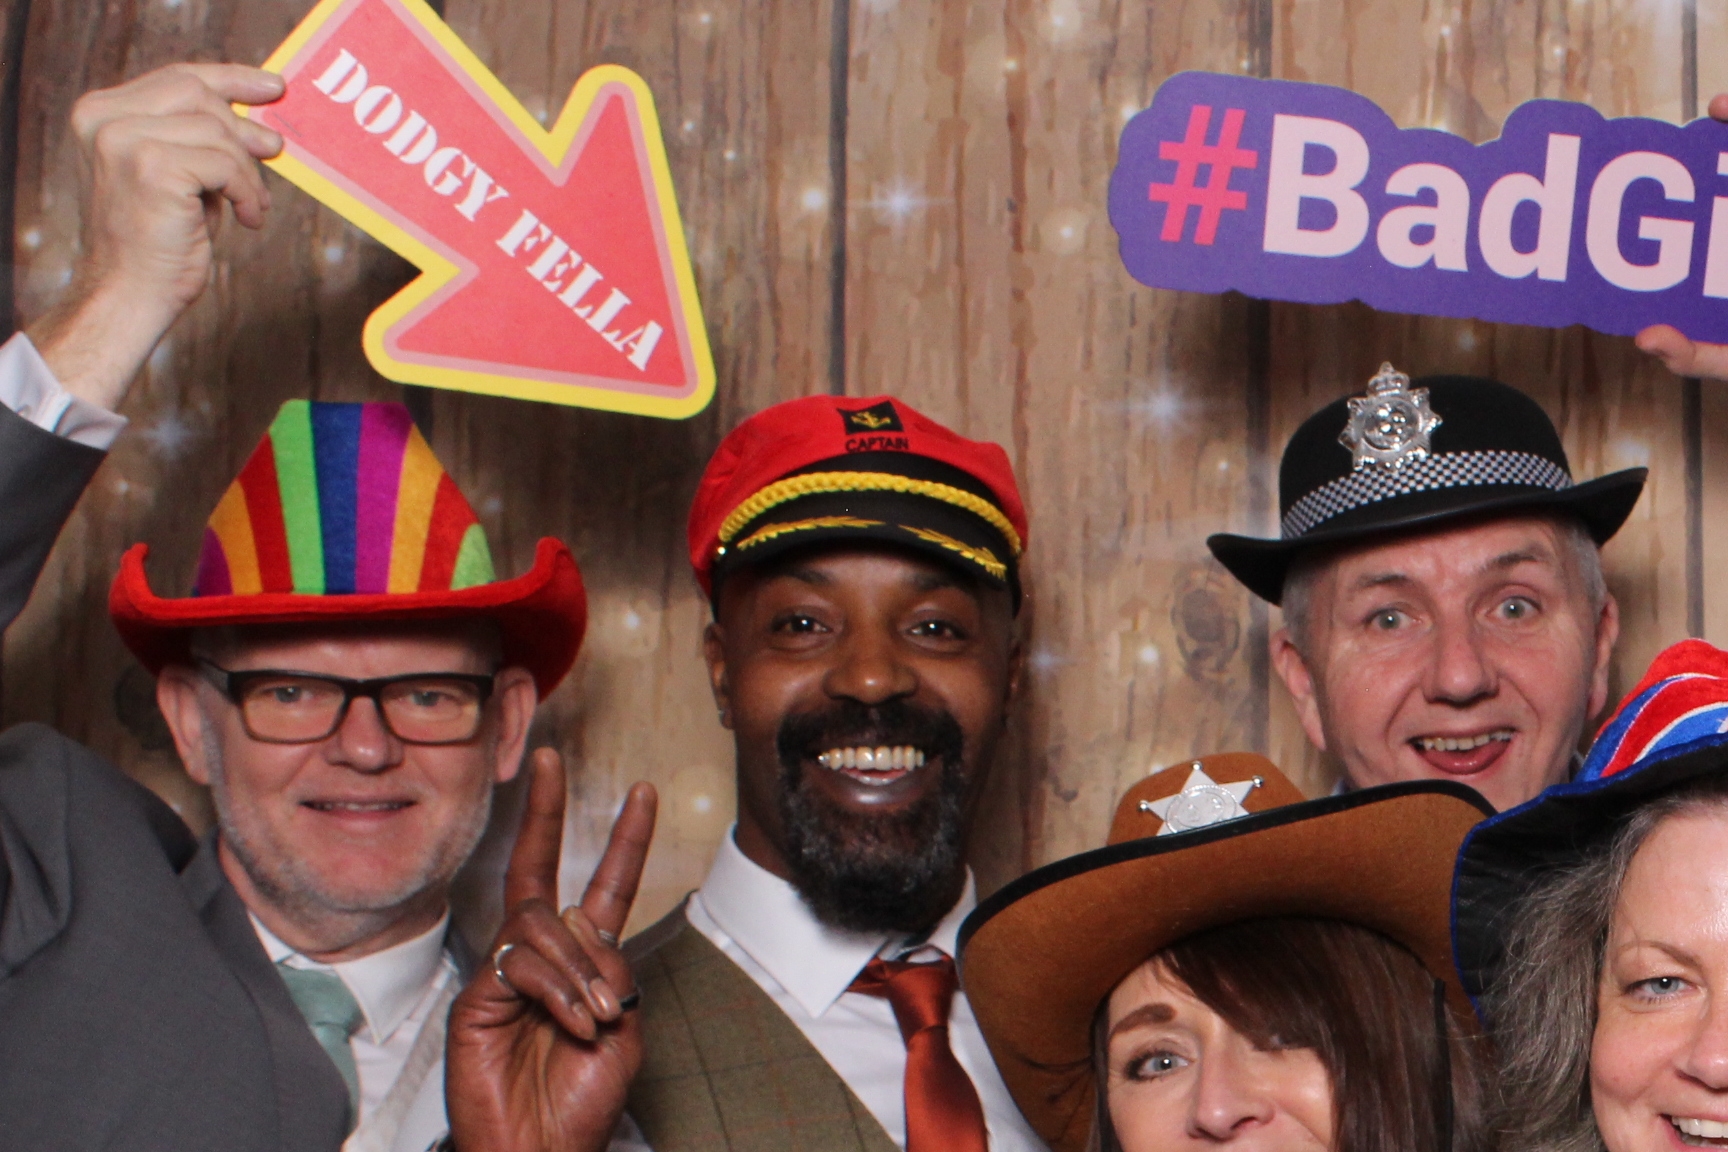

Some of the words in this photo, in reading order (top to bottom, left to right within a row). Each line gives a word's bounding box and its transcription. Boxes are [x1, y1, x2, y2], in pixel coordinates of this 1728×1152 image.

[312, 48, 509, 222] DODGY
[495, 208, 664, 372] FELLA
[845, 437, 910, 454] CAPTAIN
